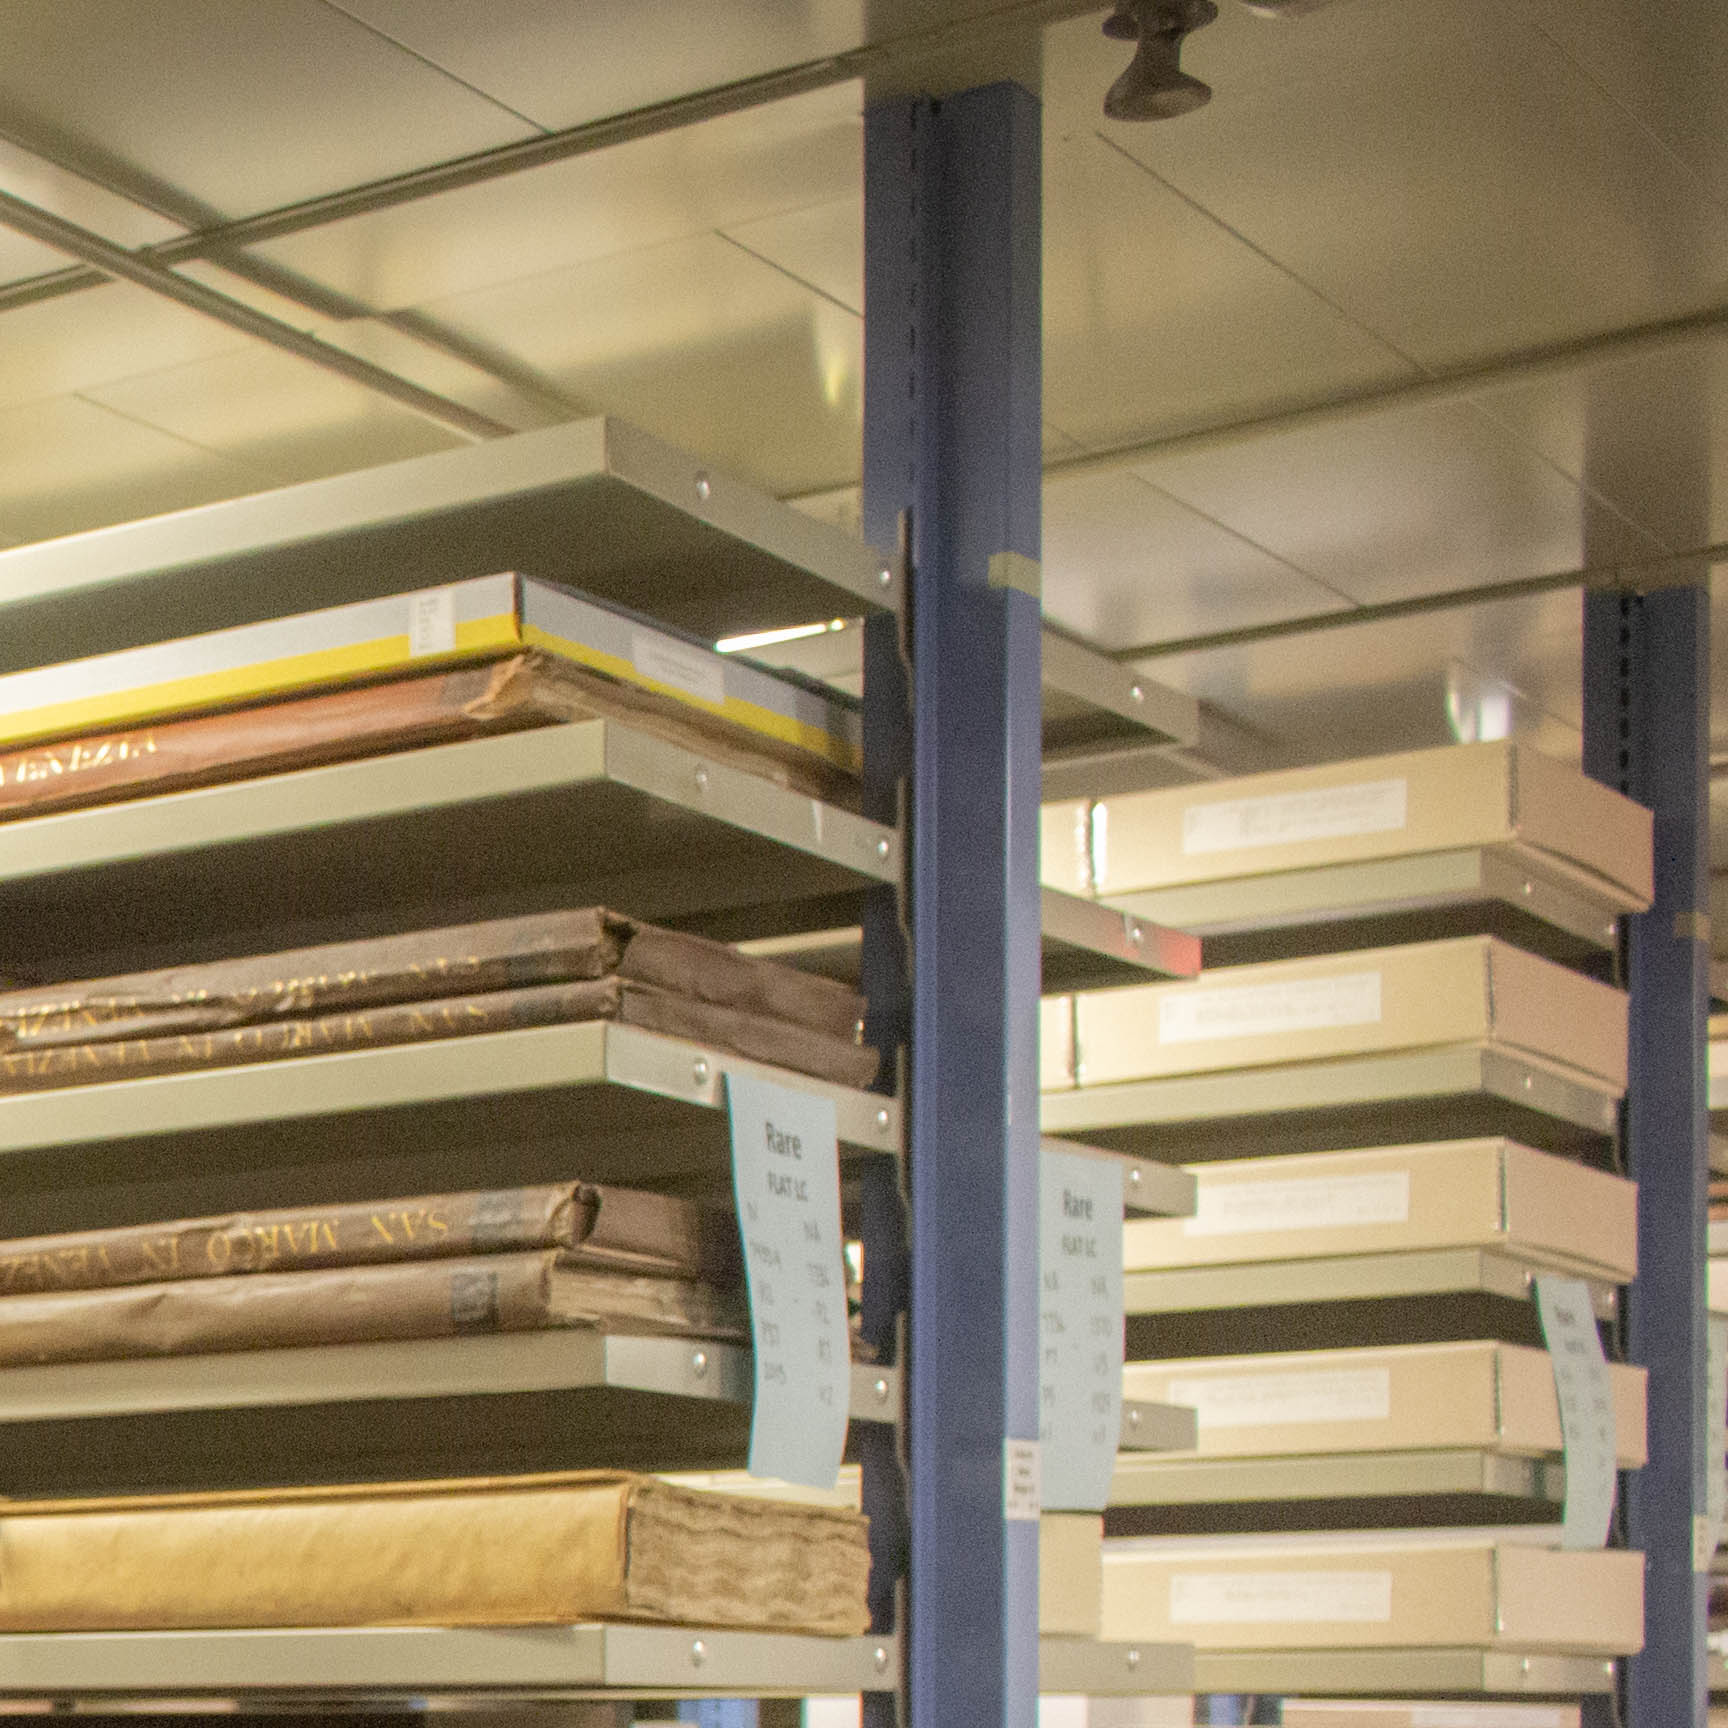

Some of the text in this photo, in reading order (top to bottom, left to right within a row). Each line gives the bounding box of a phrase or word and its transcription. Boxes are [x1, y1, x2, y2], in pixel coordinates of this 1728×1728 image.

[765, 1121, 802, 1160] Rare
[1062, 1188, 1093, 1221] Rare
[206, 1218, 340, 1266] MARCO
[370, 1207, 450, 1244] SAN
